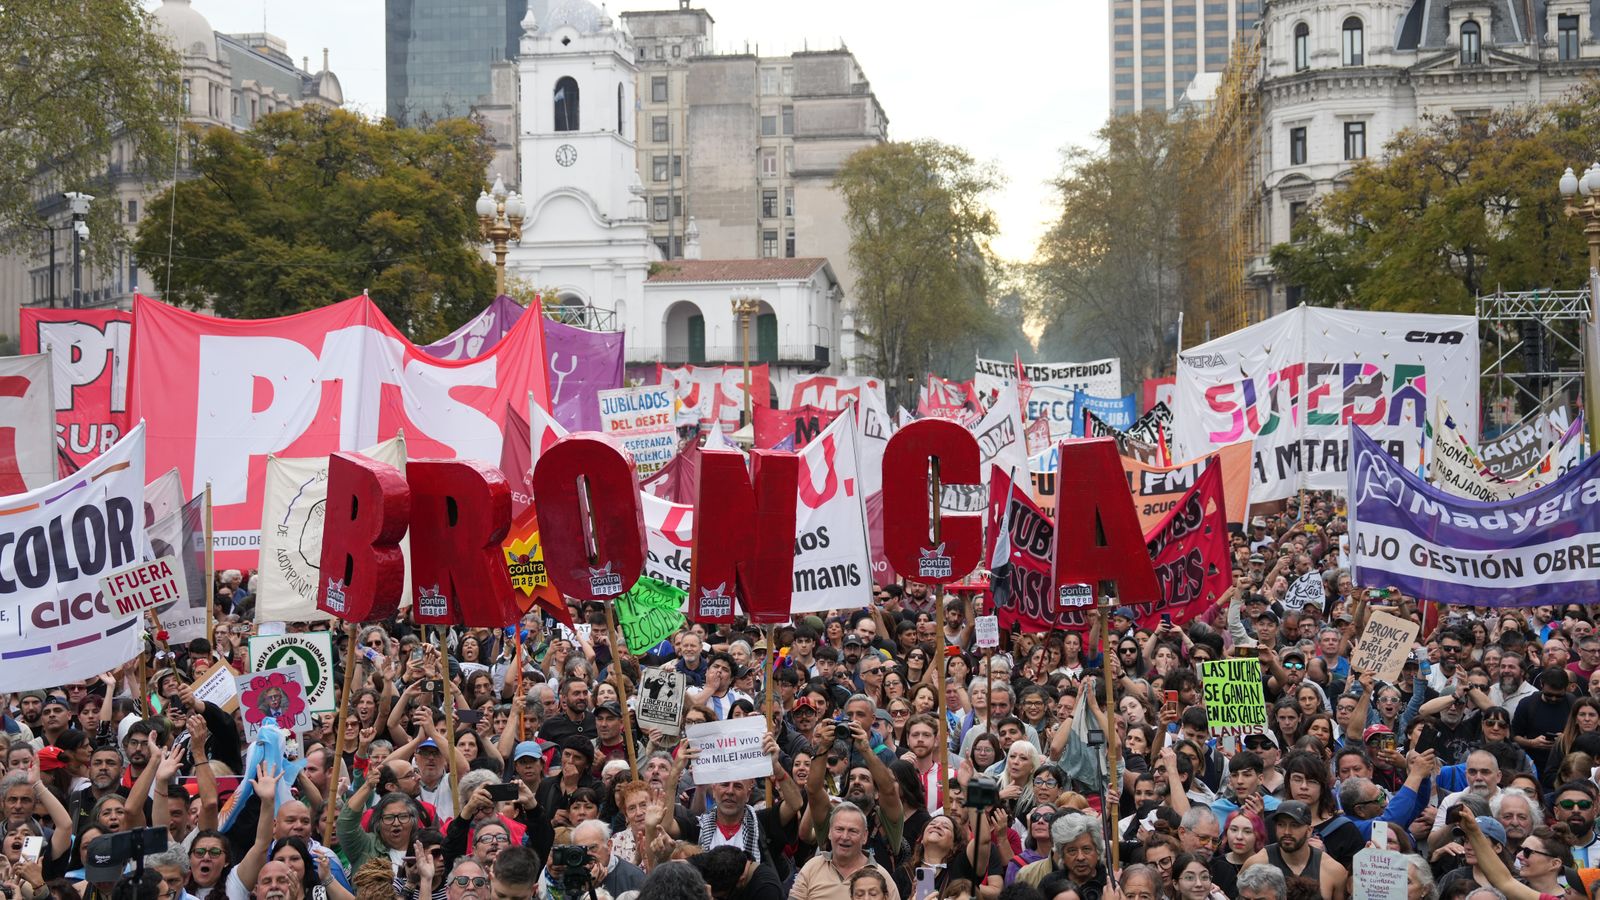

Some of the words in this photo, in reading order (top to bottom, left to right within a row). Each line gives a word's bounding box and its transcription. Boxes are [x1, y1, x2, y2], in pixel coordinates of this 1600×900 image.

[1405, 330, 1464, 345] CTA
[1051, 362, 1113, 379] DESPEDIDOS
[1205, 362, 1427, 443] SUTEBA
[193, 325, 504, 505] PTS
[611, 419, 631, 431] DEL
[635, 413, 669, 427] OESTE
[625, 436, 673, 450] ESPERANZA
[1275, 439, 1405, 481] MATAA
[196, 536, 246, 546] PRTIDO
[509, 563, 544, 574] contra
[1409, 544, 1524, 580] GESTIÓN
[106, 560, 173, 598] ¡FUERA
[592, 575, 620, 584] contra
[919, 569, 951, 577] imagen
[115, 579, 181, 616] MILEI!
[1061, 586, 1091, 596] contra
[420, 597, 445, 605] contra
[701, 598, 729, 606] contra
[1060, 596, 1093, 606] imagen
[700, 608, 730, 617] imagen
[1366, 621, 1410, 643] BRONCA
[1360, 641, 1392, 657] BRAVA
[1371, 637, 1383, 645] DE
[1388, 641, 1399, 650] LA
[256, 649, 268, 672] POSTA
[267, 643, 276, 653] DE
[276, 637, 298, 647] SALUD
[305, 641, 327, 667] CUIDADO
[317, 676, 328, 698] POSTA
[1202, 661, 1225, 678] LAS
[1228, 660, 1262, 683] LUCHAS
[1204, 683, 1220, 702] SE
[1222, 682, 1261, 705] GANAN
[1207, 705, 1219, 722] EN
[1221, 705, 1237, 724] LAS
[1238, 704, 1266, 725] CALLES
[700, 742, 716, 750] CON
[716, 737, 737, 749] VIH
[739, 736, 760, 746] VIVO
[696, 757, 711, 765] CON
[712, 752, 739, 764] MILEI
